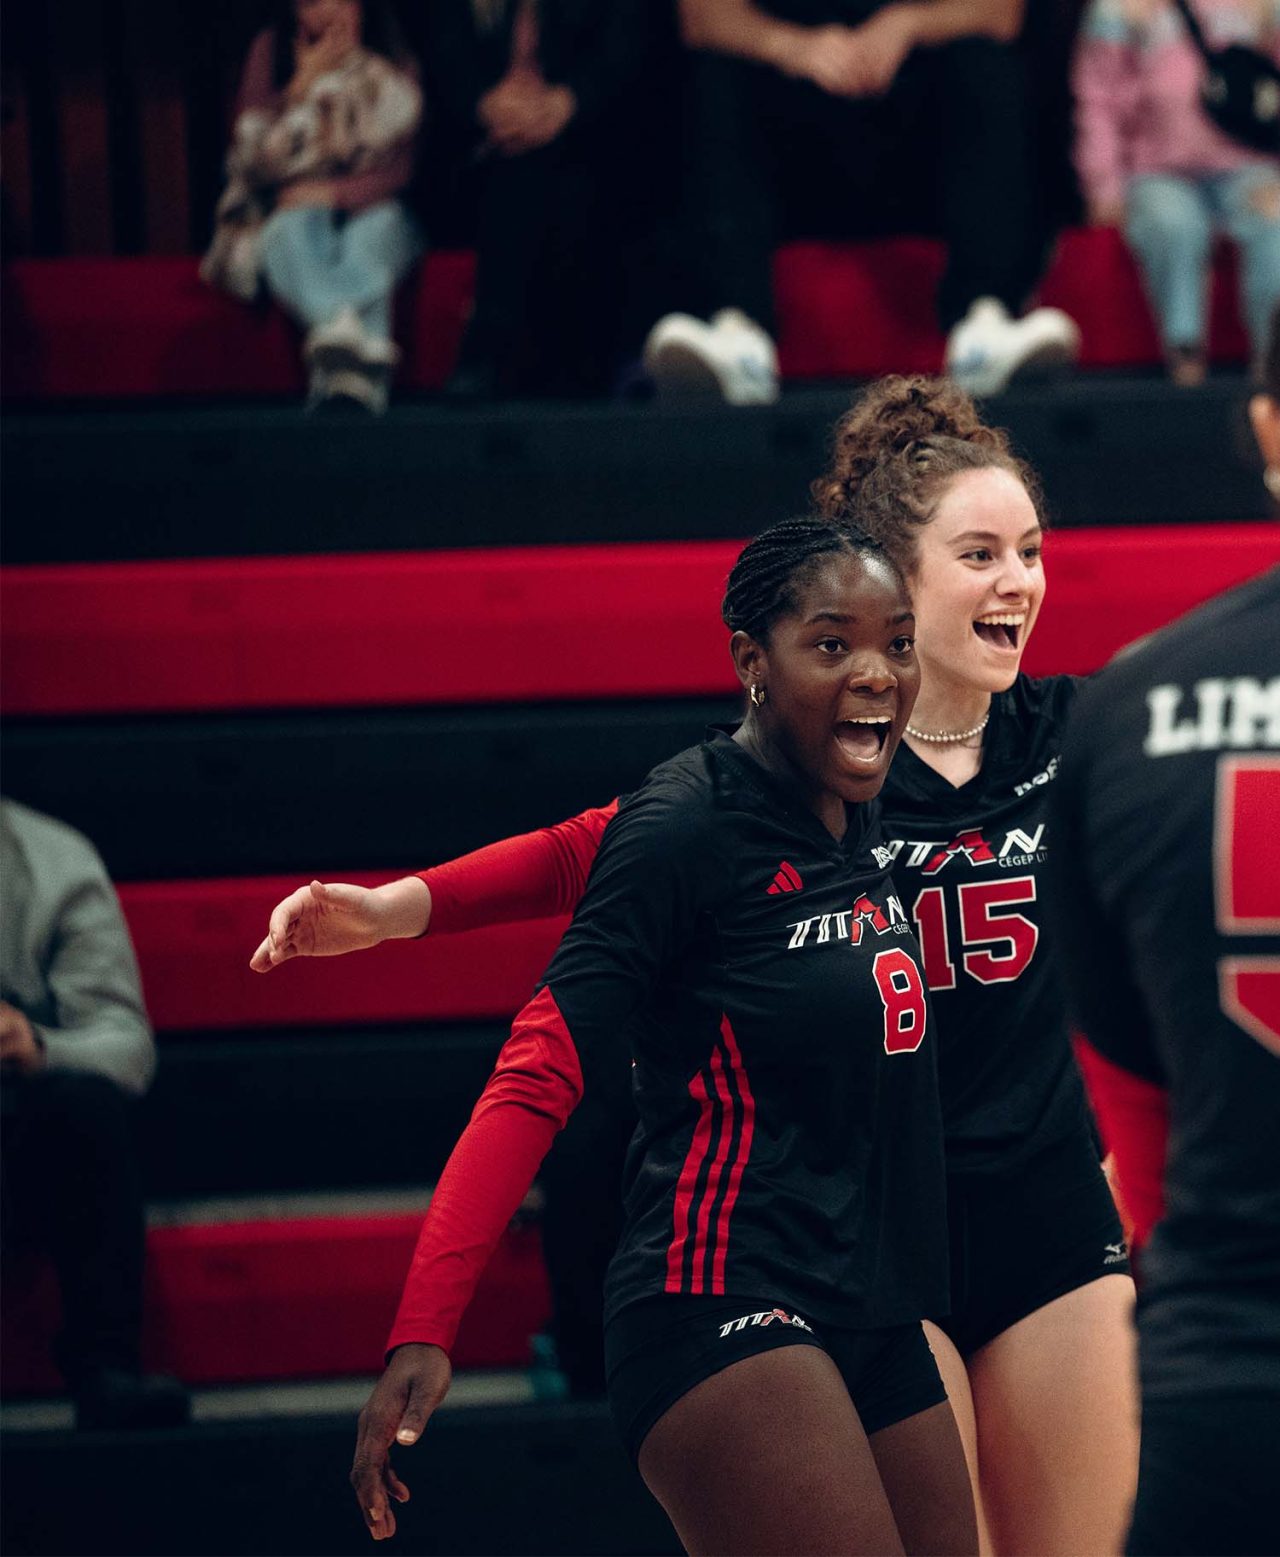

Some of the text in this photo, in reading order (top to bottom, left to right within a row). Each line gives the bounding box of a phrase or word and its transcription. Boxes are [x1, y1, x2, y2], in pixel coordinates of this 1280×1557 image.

[785, 892, 908, 949] TITAN
[912, 875, 1039, 992] 15
[872, 947, 927, 1056] 8
